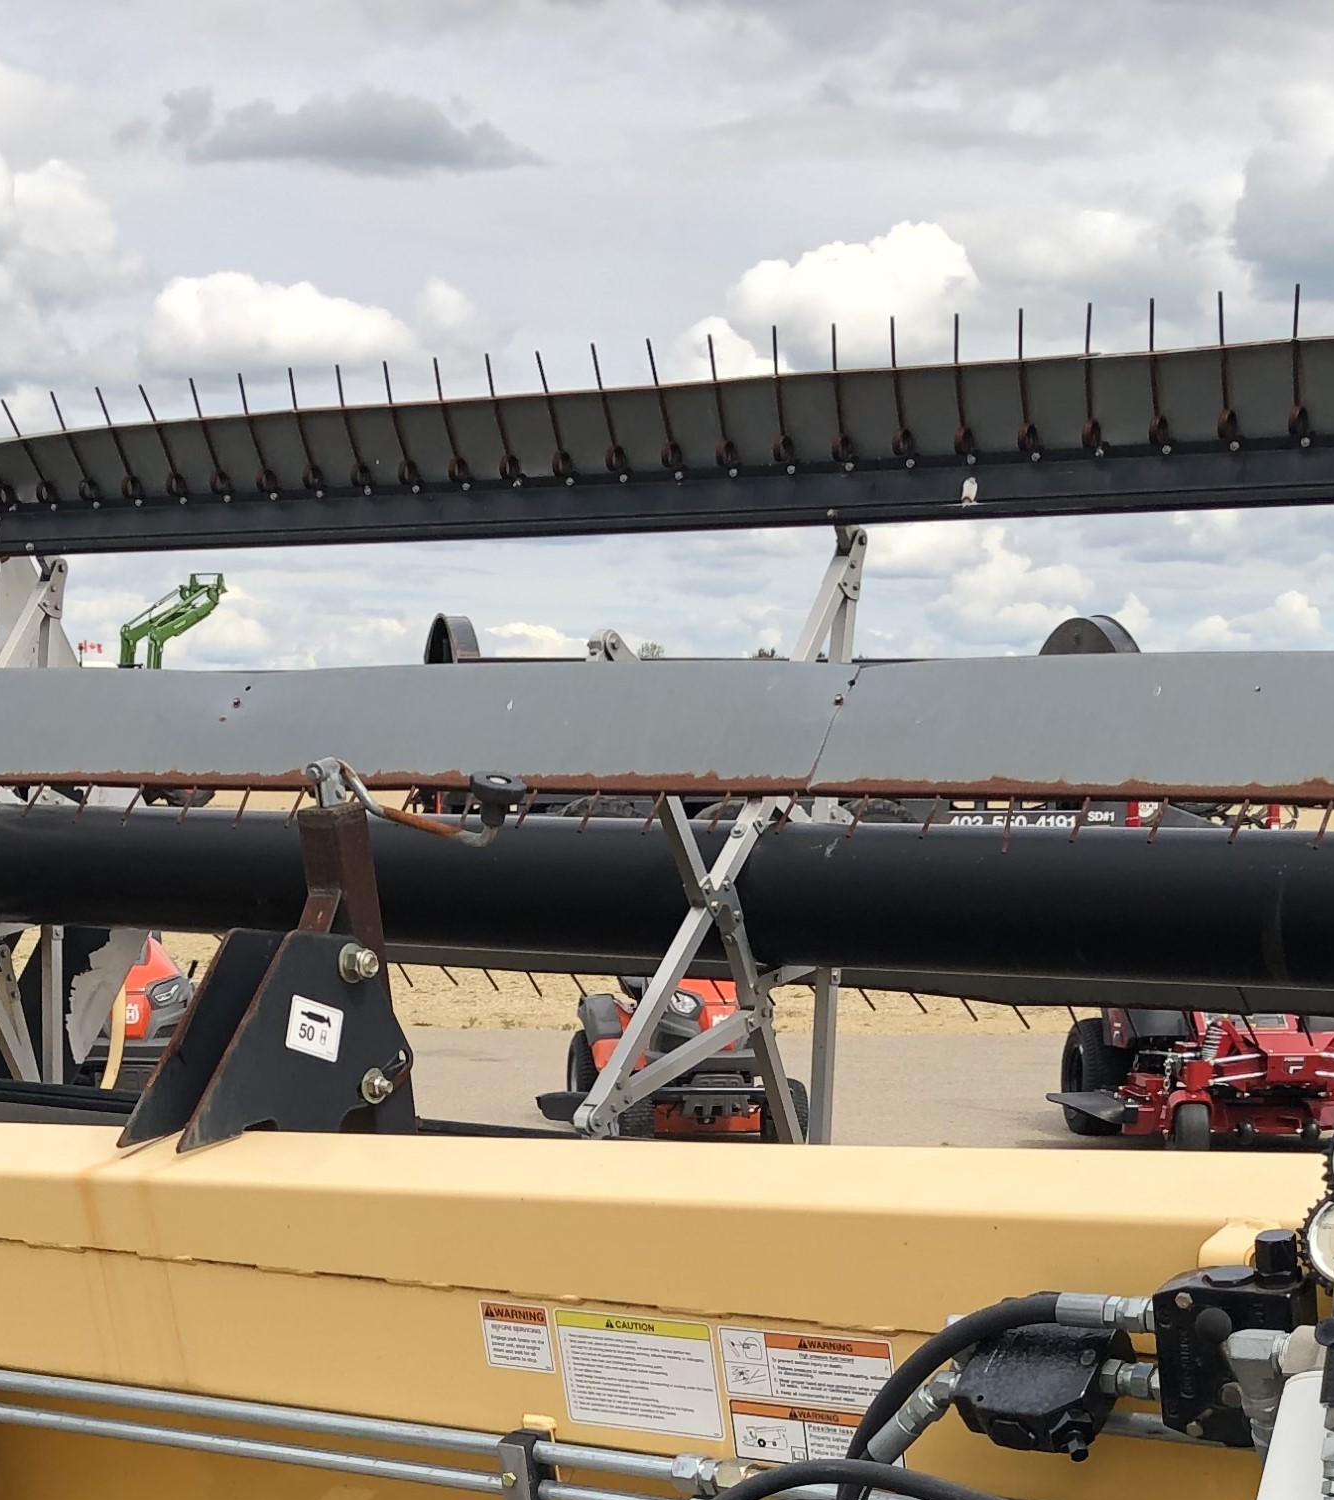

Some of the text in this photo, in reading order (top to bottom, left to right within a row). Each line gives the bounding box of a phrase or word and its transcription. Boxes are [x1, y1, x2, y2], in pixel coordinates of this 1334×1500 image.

[1087, 811, 1115, 822] SD#1
[298, 1022, 315, 1041] 50
[494, 1308, 545, 1322] WARNING
[615, 1320, 655, 1332] CAUTION
[807, 1340, 854, 1353] WARNING
[797, 1410, 839, 1422] WARNING
